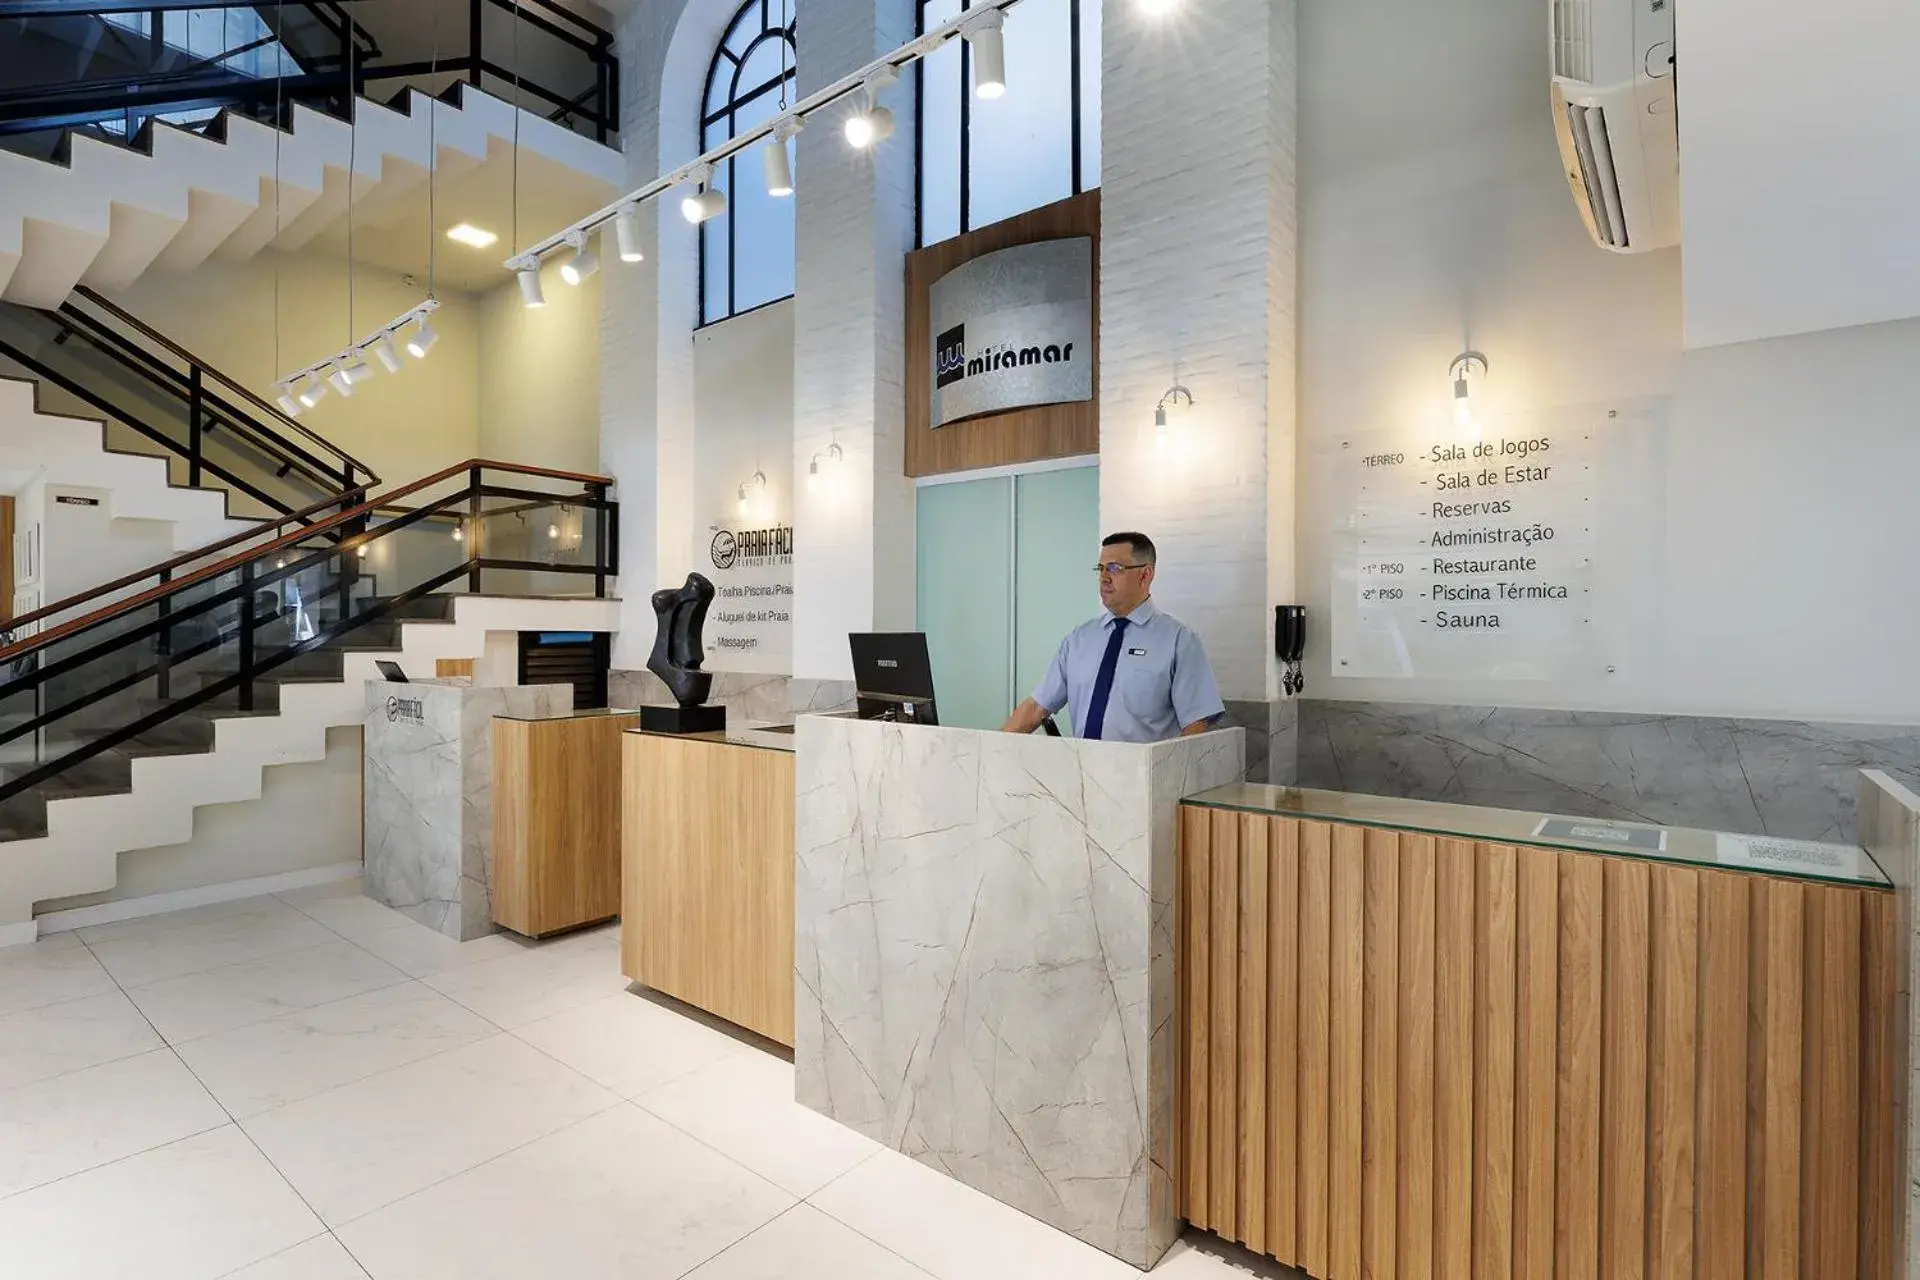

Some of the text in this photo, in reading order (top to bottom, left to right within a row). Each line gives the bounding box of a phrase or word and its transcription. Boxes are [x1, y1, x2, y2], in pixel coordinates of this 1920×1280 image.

[967, 343, 1073, 377] miramar
[1365, 453, 1404, 467] TÉRREO
[1431, 444, 1466, 463] Sala
[1472, 442, 1493, 458] de
[1500, 437, 1550, 458] Jogos
[1436, 472, 1470, 490] Sala
[1477, 469, 1498, 486] de
[1505, 465, 1551, 484] Estar
[1432, 500, 1511, 518] Reservas
[738, 522, 793, 557] PRAIAFÁCI
[1431, 524, 1555, 547] Administração
[1380, 563, 1404, 574] PISO
[1433, 556, 1537, 574] Restaurante
[1379, 588, 1404, 600] PISO
[1432, 584, 1490, 600] Piscina
[1497, 582, 1568, 599] Térmica
[746, 611, 756, 622] de
[768, 610, 789, 622] Praia
[1436, 611, 1500, 628] Sauna
[717, 636, 758, 650] Massagem
